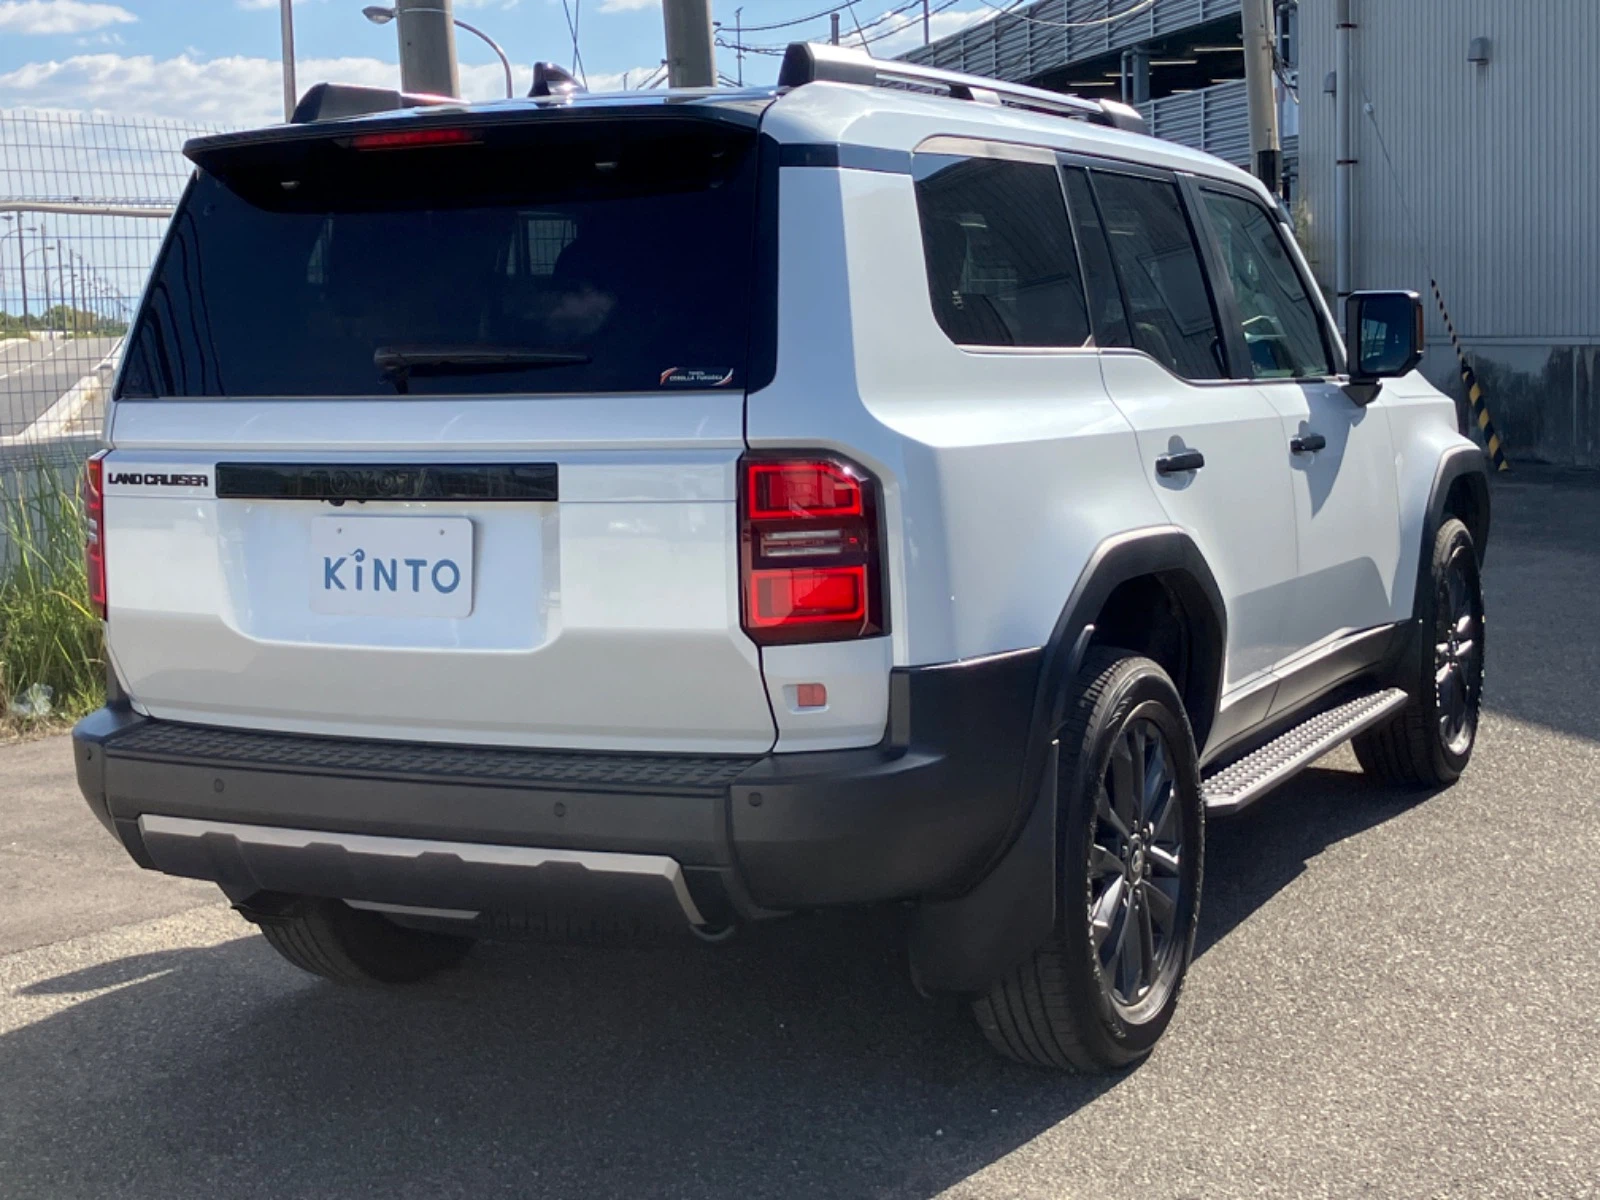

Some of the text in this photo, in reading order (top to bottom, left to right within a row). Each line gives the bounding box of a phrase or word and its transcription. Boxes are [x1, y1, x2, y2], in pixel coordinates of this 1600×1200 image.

[108, 472, 209, 487] LAND CRUISER
[310, 469, 443, 496] TOYOTA
